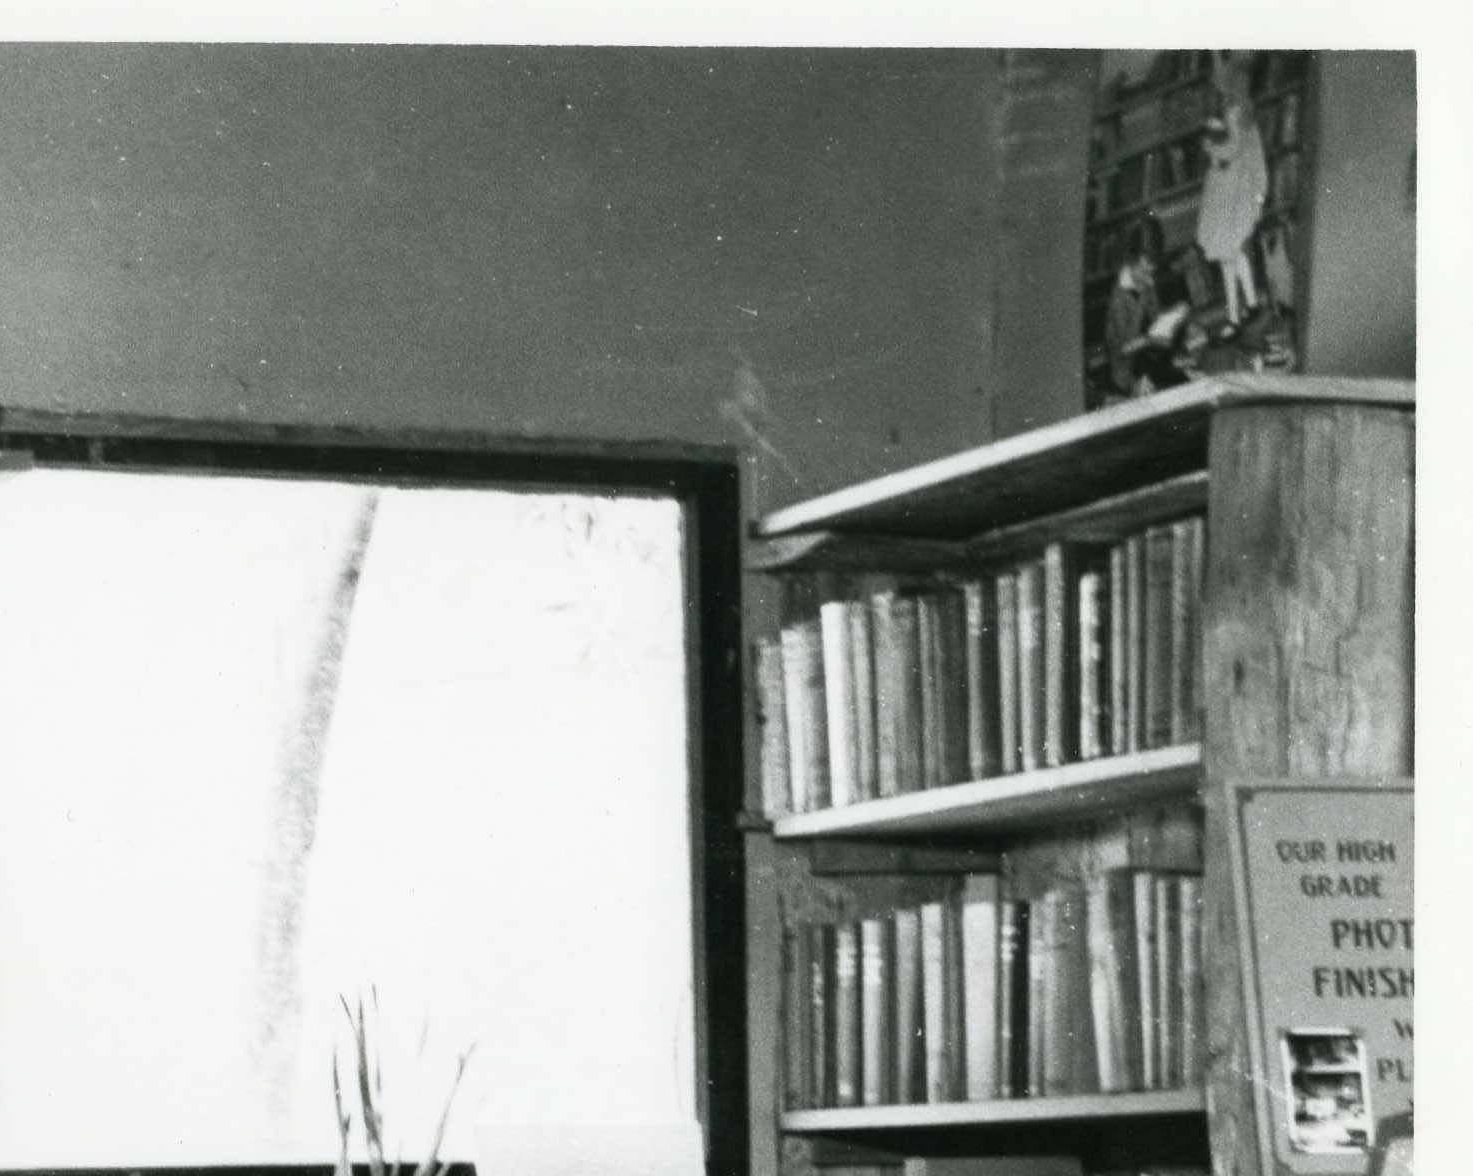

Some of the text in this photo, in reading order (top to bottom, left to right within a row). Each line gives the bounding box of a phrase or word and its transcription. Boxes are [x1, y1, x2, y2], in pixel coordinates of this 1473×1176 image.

[1275, 839, 1396, 864] OUR HIGH
[1300, 874, 1383, 899] GRADE
